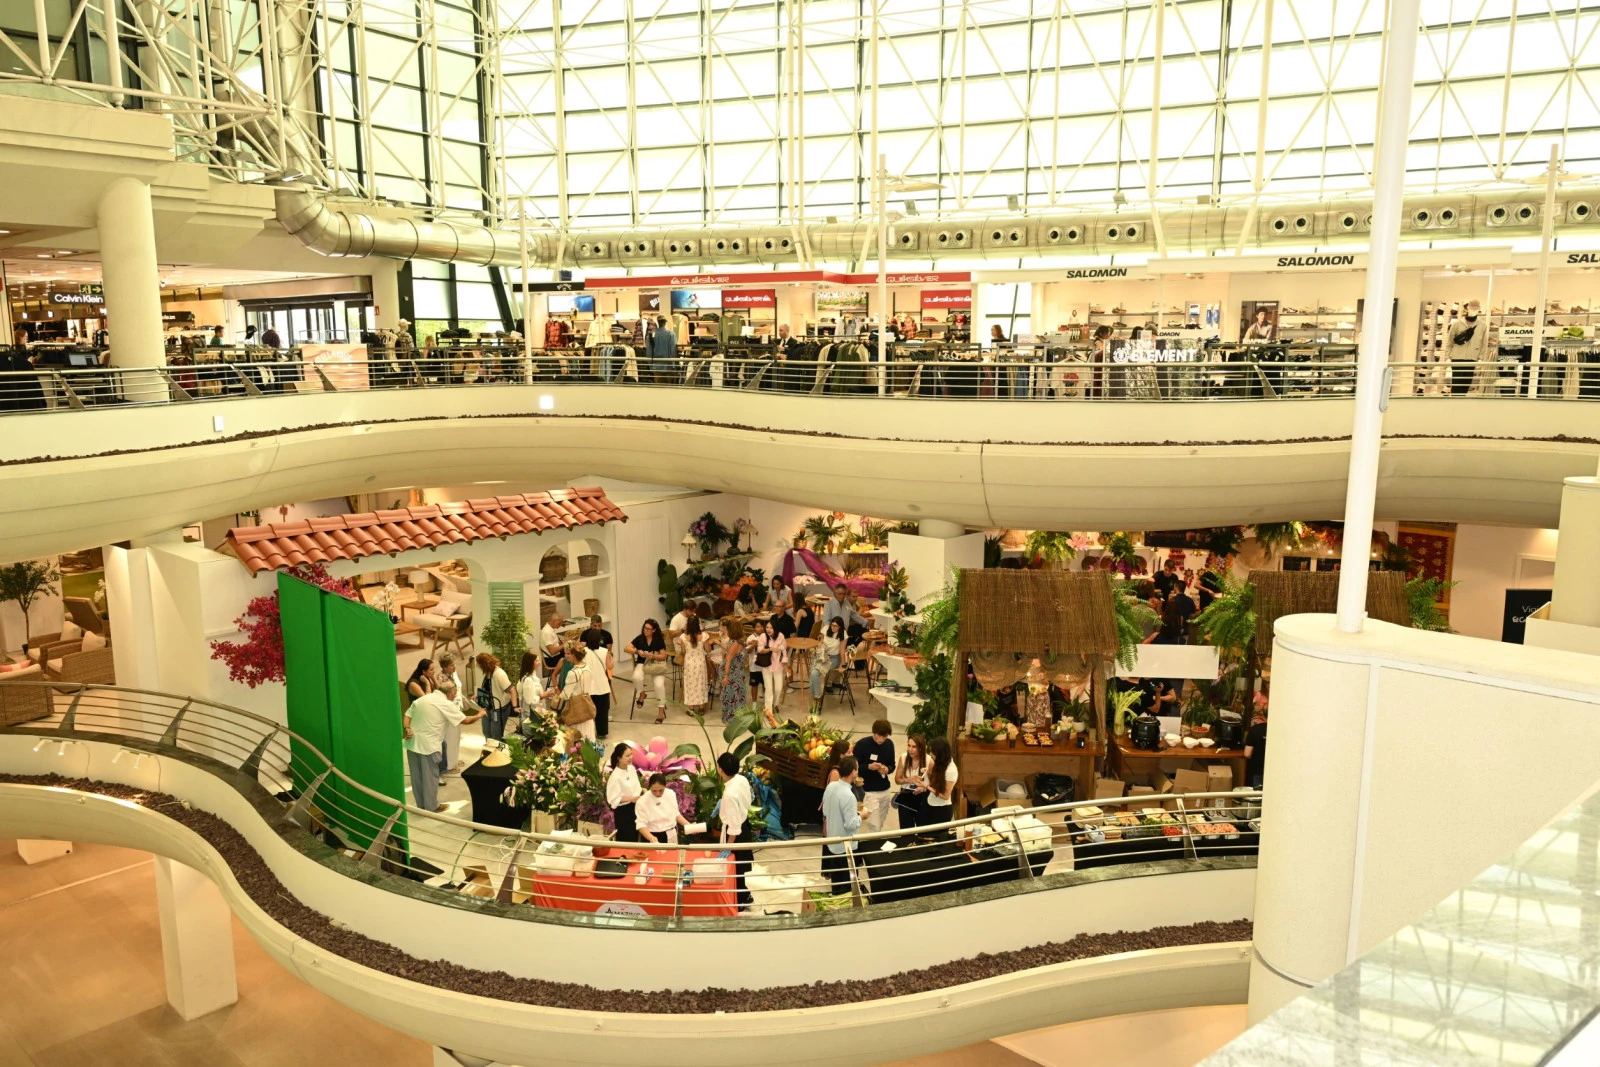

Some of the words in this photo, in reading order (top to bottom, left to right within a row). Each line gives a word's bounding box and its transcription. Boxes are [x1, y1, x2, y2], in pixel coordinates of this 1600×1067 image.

[1277, 255, 1354, 267] SALOMON
[1566, 253, 1600, 264] SAL
[1066, 268, 1127, 279] SALOMON
[54, 293, 82, 303] Calvin
[82, 294, 103, 304] Klein
[1132, 348, 1198, 362] ELEMENT
